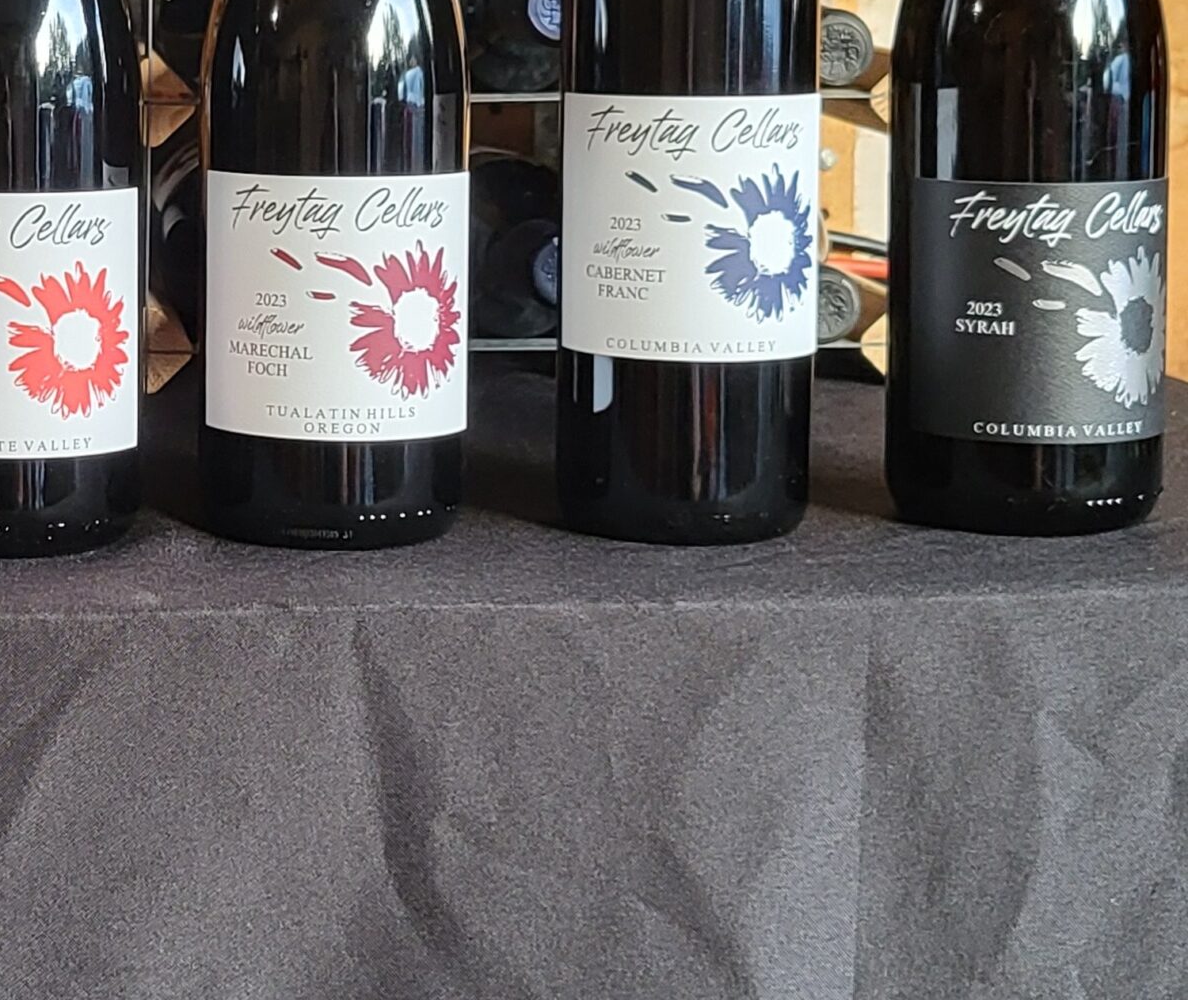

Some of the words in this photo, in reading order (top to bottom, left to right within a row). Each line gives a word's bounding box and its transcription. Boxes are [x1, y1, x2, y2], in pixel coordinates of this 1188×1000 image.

[587, 105, 700, 161] Freytag
[711, 108, 803, 153] Cellars
[232, 184, 344, 240] Freytag
[355, 186, 449, 232] Cellars
[949, 190, 1077, 248] Freytag
[1085, 189, 1164, 240] Cellars
[10, 203, 113, 250] Cellars
[609, 216, 642, 232] 2023
[593, 237, 661, 264] wildflower
[586, 264, 666, 284] CABERNET
[255, 292, 287, 308] 2023
[597, 284, 650, 301] FRANC
[966, 300, 1003, 317] 2023
[238, 313, 306, 340] wildflower
[955, 318, 1015, 336] SYRAH
[228, 340, 313, 361] MARECHAL
[605, 337, 703, 354] COLUMBIA
[705, 340, 777, 354] VALLEY
[247, 361, 288, 378] FOCH
[266, 404, 361, 421] TUALATIN
[366, 406, 417, 420] HILLS
[303, 421, 381, 435] OREGON
[973, 421, 1077, 439] COLUMBIA
[1082, 420, 1144, 437] VALLEY
[24, 436, 93, 452] VALLEY
